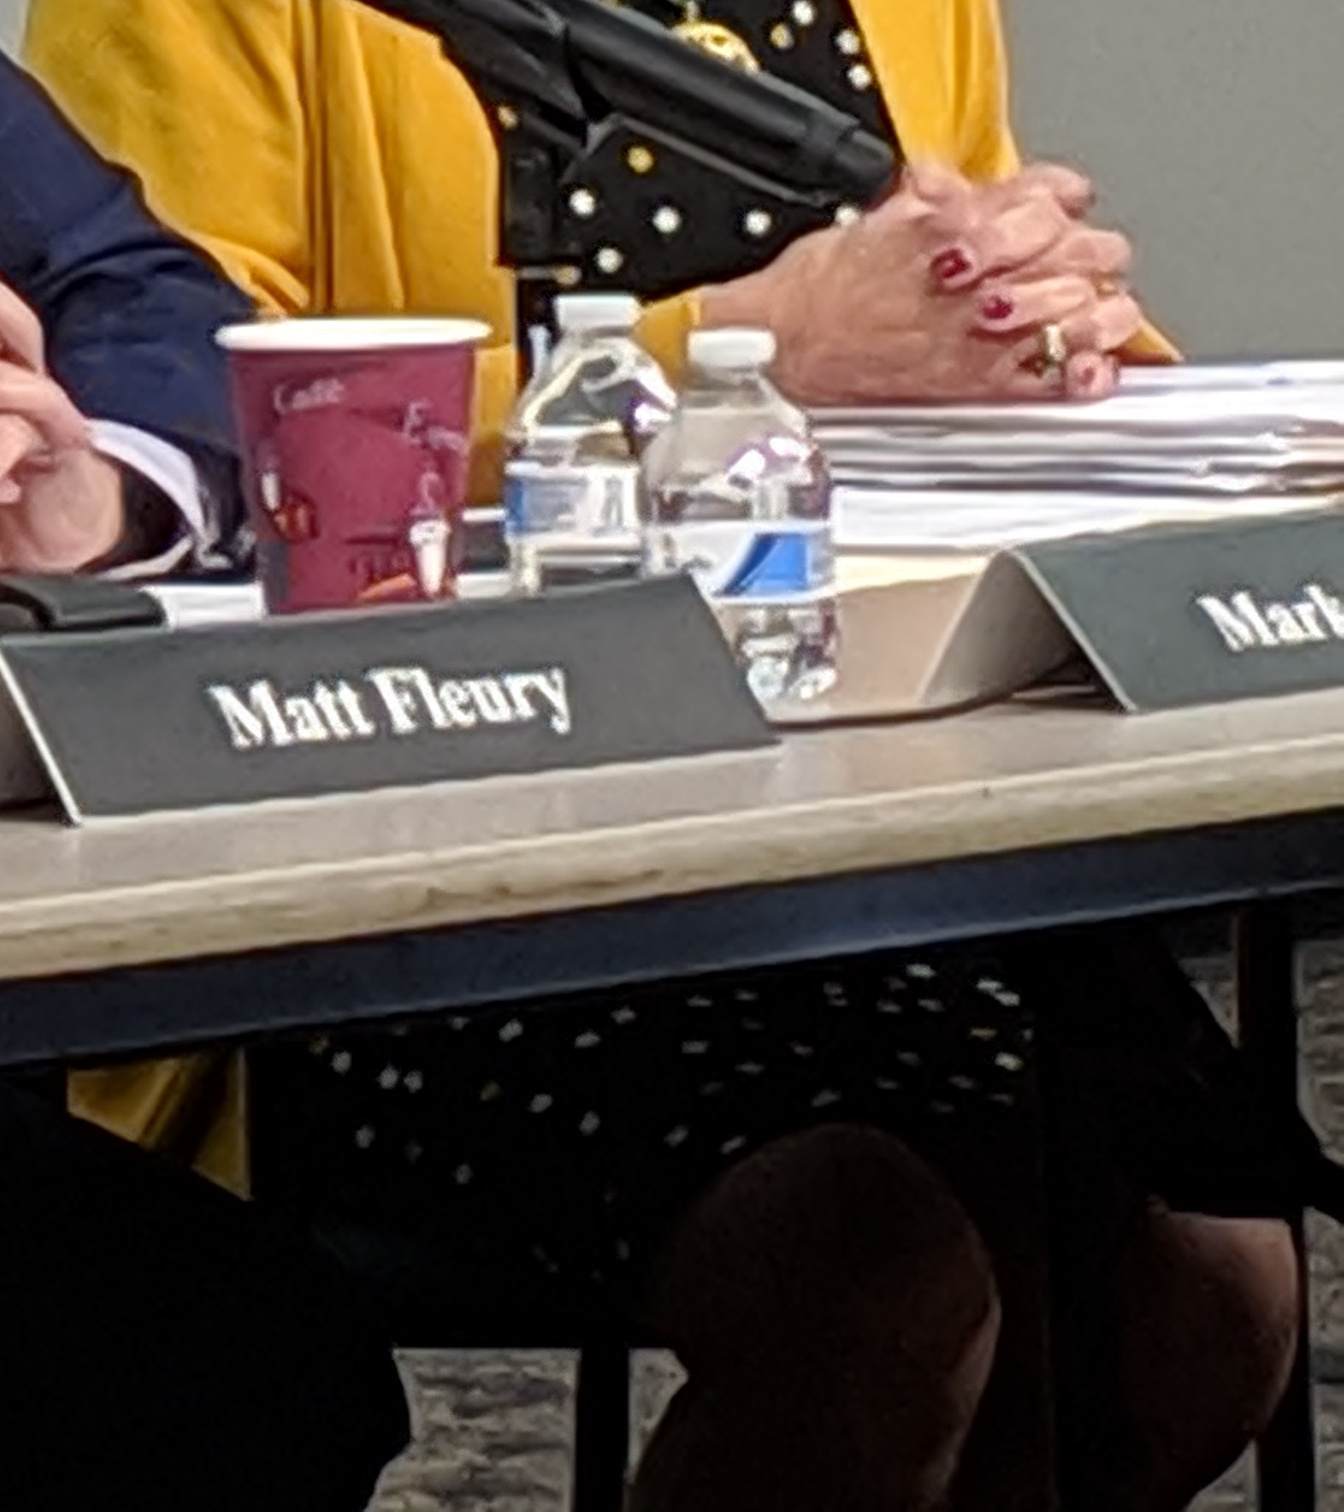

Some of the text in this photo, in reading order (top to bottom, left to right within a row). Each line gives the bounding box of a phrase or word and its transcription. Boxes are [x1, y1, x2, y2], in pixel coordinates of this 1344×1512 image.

[1195, 584, 1344, 652] Mark
[208, 667, 571, 749] Matt Fleury
